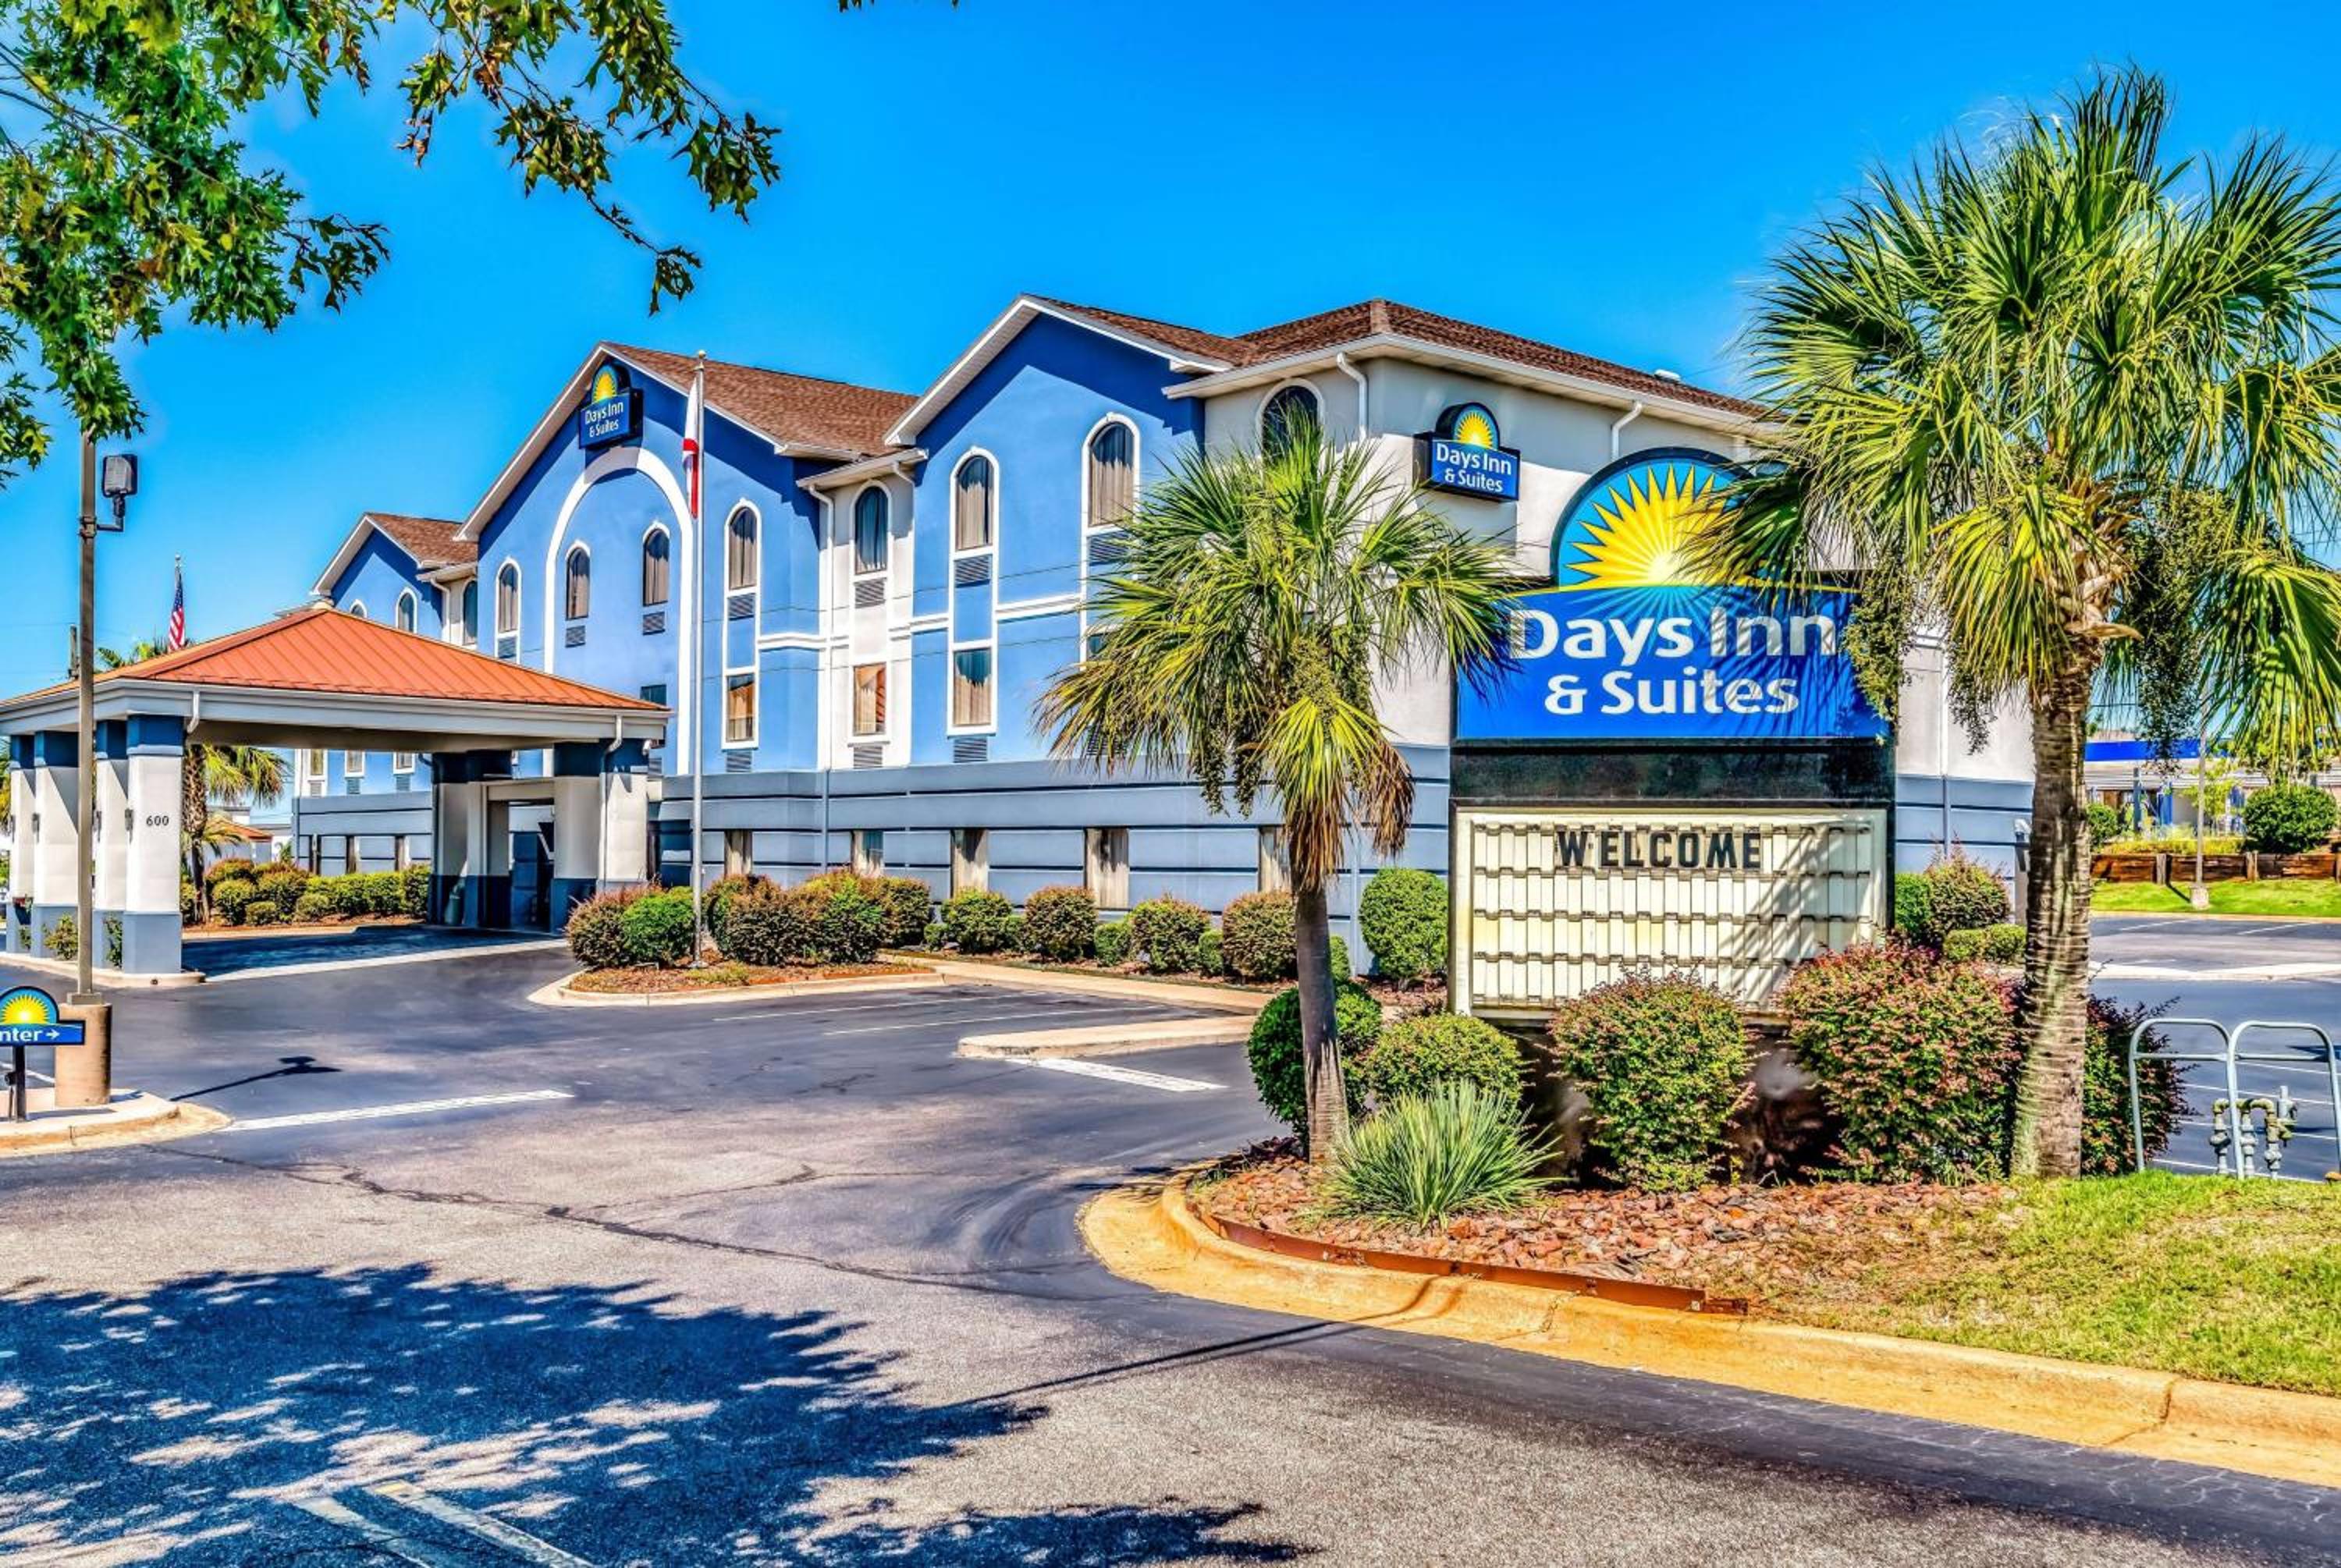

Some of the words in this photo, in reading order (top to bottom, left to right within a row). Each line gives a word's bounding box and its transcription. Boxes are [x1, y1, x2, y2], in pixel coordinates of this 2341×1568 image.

[585, 406, 606, 425] Days
[608, 402, 623, 417] Inn
[589, 426, 595, 438] &
[595, 419, 619, 436] Suites
[1437, 442, 1480, 469] Days
[1483, 452, 1512, 475] Inn
[1444, 467, 1455, 483] &
[1458, 469, 1503, 492] Suites
[1510, 608, 1694, 667] Days
[1710, 607, 1836, 657] Inn
[1544, 675, 1587, 715] &
[1600, 665, 1799, 715] Suites
[146, 815, 169, 827] 600
[1558, 831, 1761, 868] WELCOME
[0, 1027, 43, 1042] nter
